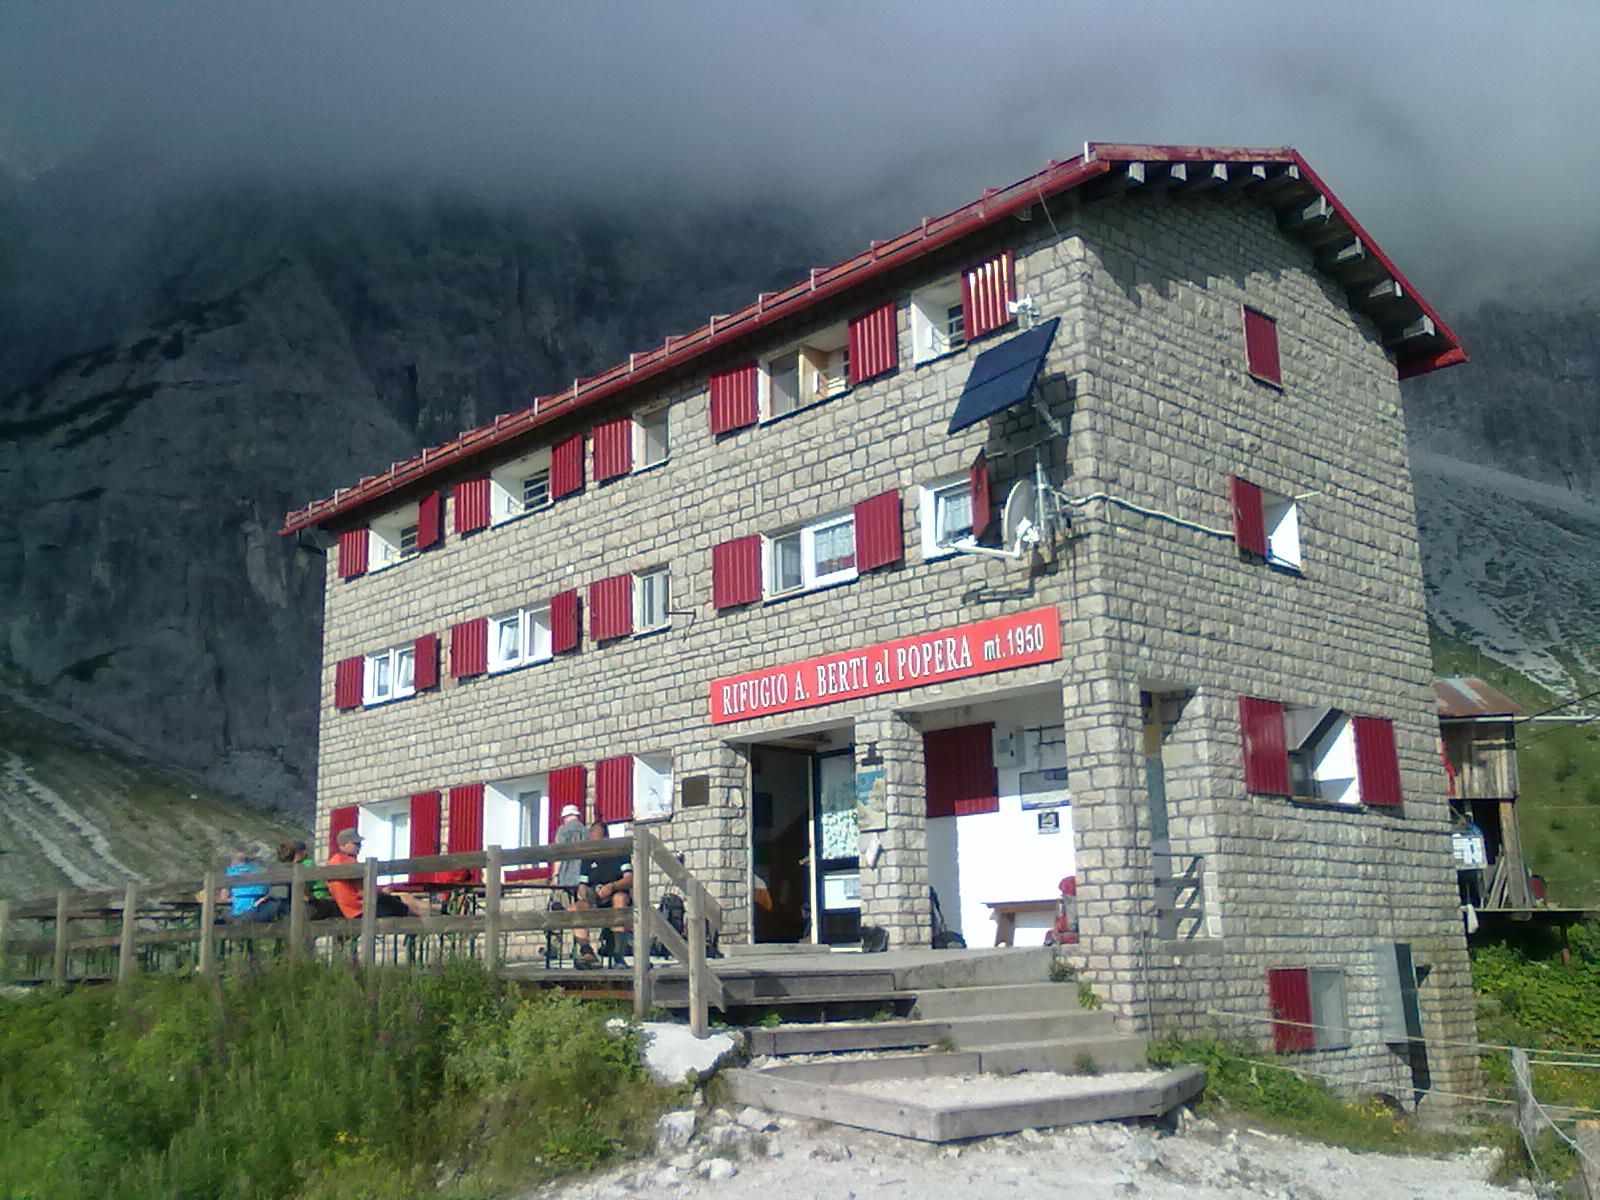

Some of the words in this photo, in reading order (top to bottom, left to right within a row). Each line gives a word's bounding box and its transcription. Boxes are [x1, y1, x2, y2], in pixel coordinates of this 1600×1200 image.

[722, 672, 788, 715] RIFUGIO
[794, 670, 811, 701] A.
[816, 655, 869, 697] BERTI
[896, 634, 973, 681] POPERA
